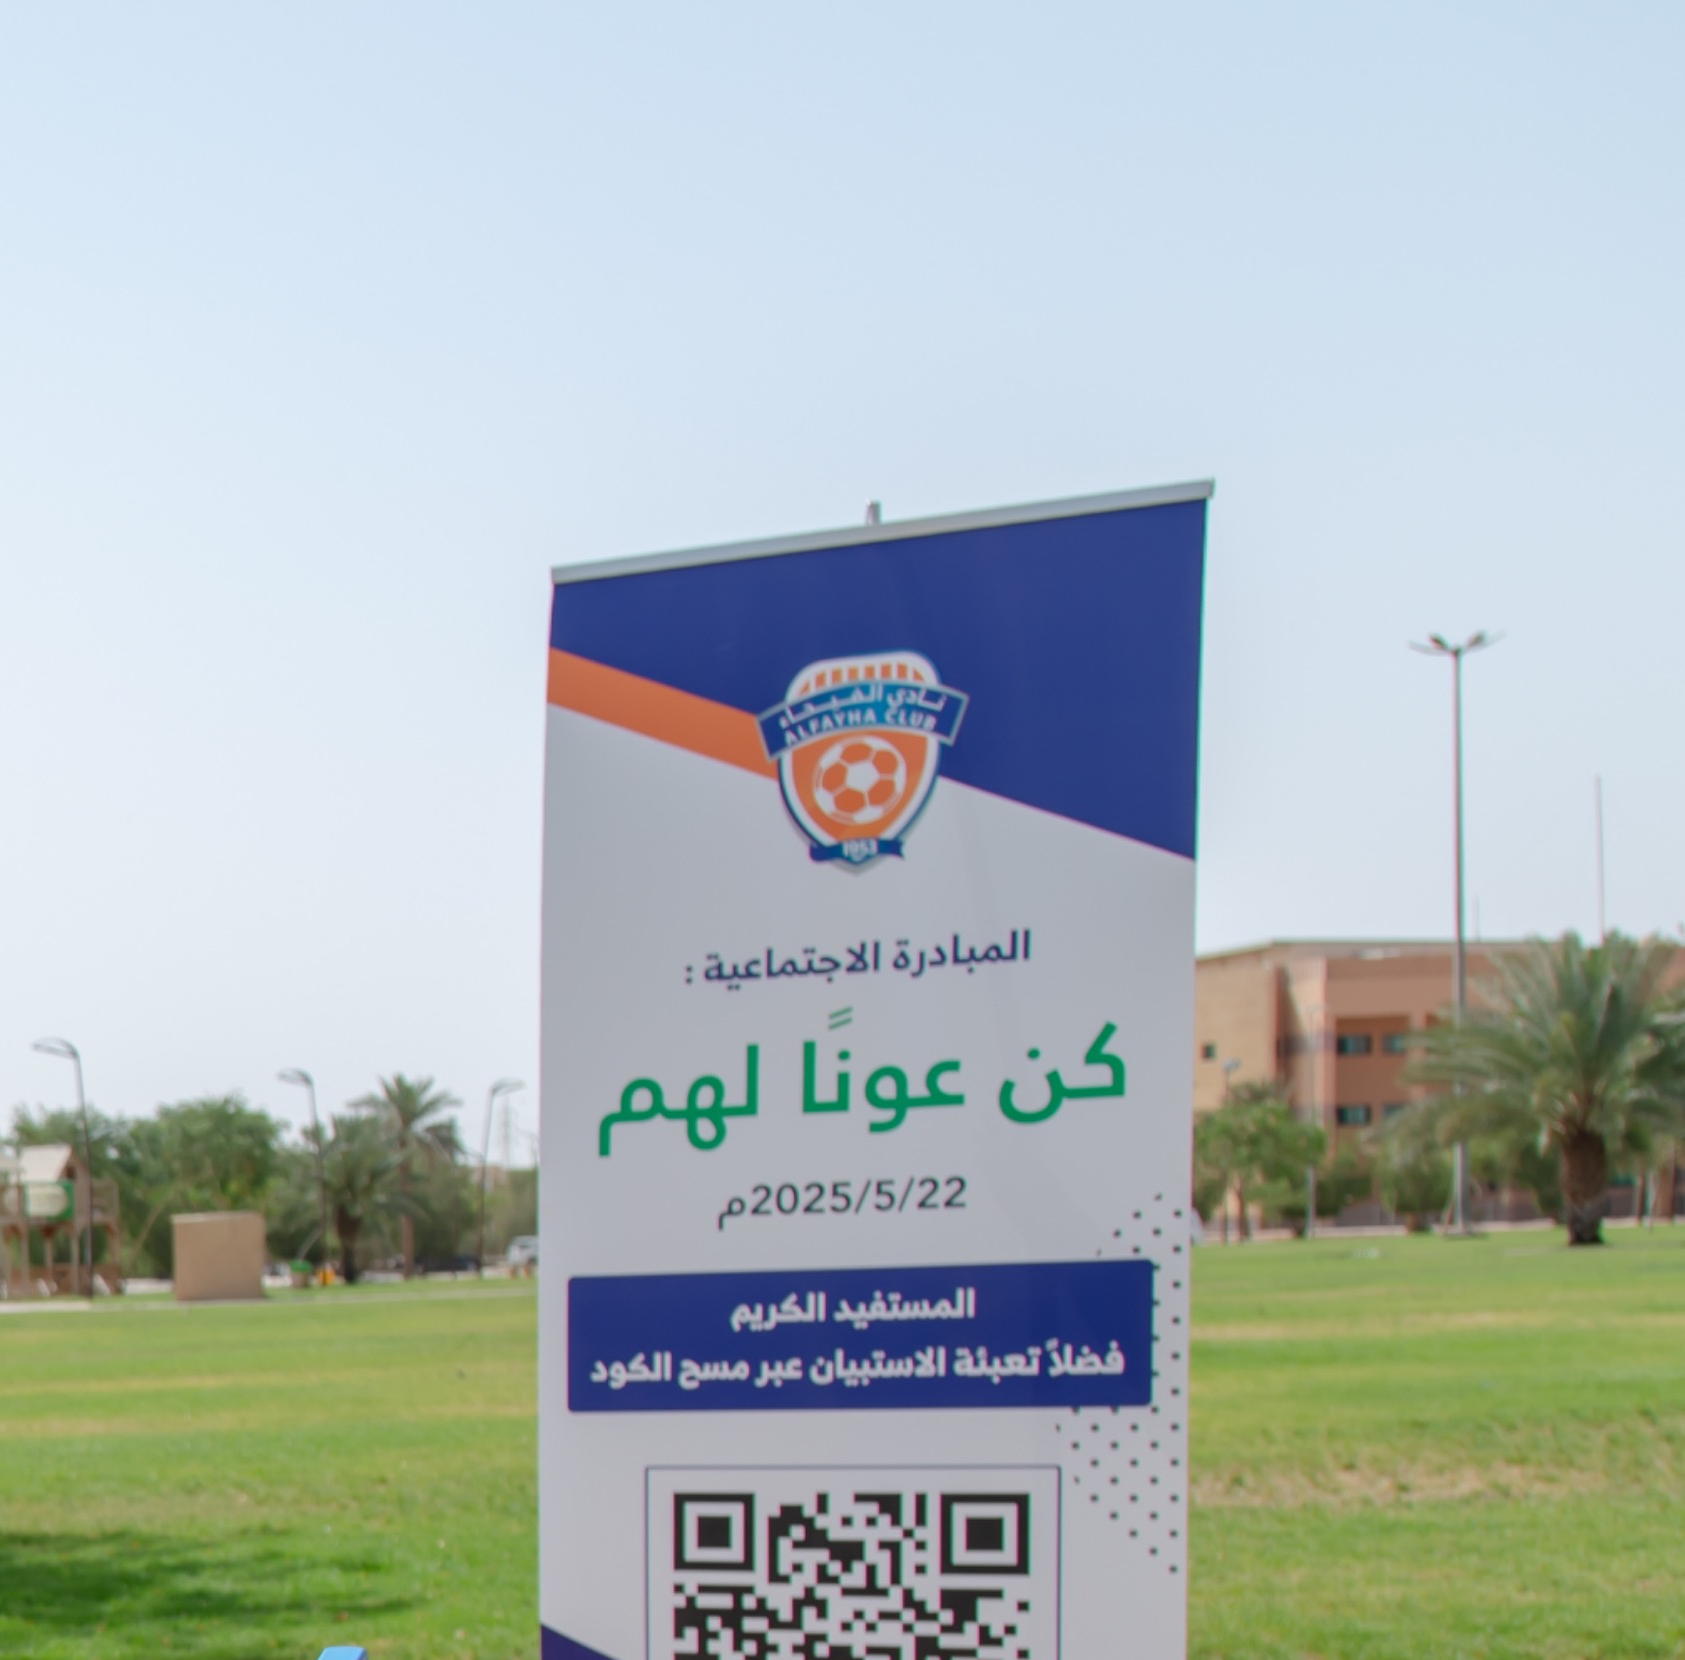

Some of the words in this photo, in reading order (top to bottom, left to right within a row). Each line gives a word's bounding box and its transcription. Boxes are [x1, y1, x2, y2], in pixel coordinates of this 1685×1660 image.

[783, 708, 877, 747] ALFAYHA
[885, 709, 937, 733] CLUB
[704, 940, 881, 991] الاجتماعية
[892, 928, 1031, 978] المبادرة
[801, 1004, 966, 1134] عونًا
[997, 1021, 1126, 1124] كن
[598, 1043, 760, 1158] لهم
[730, 1292, 826, 1332] الكريم
[833, 1287, 976, 1329] المستفيد
[590, 1350, 671, 1389] الكود
[677, 1359, 749, 1390] مسح
[753, 1356, 803, 1388] عبر
[809, 1346, 947, 1387] الاستبيان
[953, 1345, 1040, 1384] تعبئة
